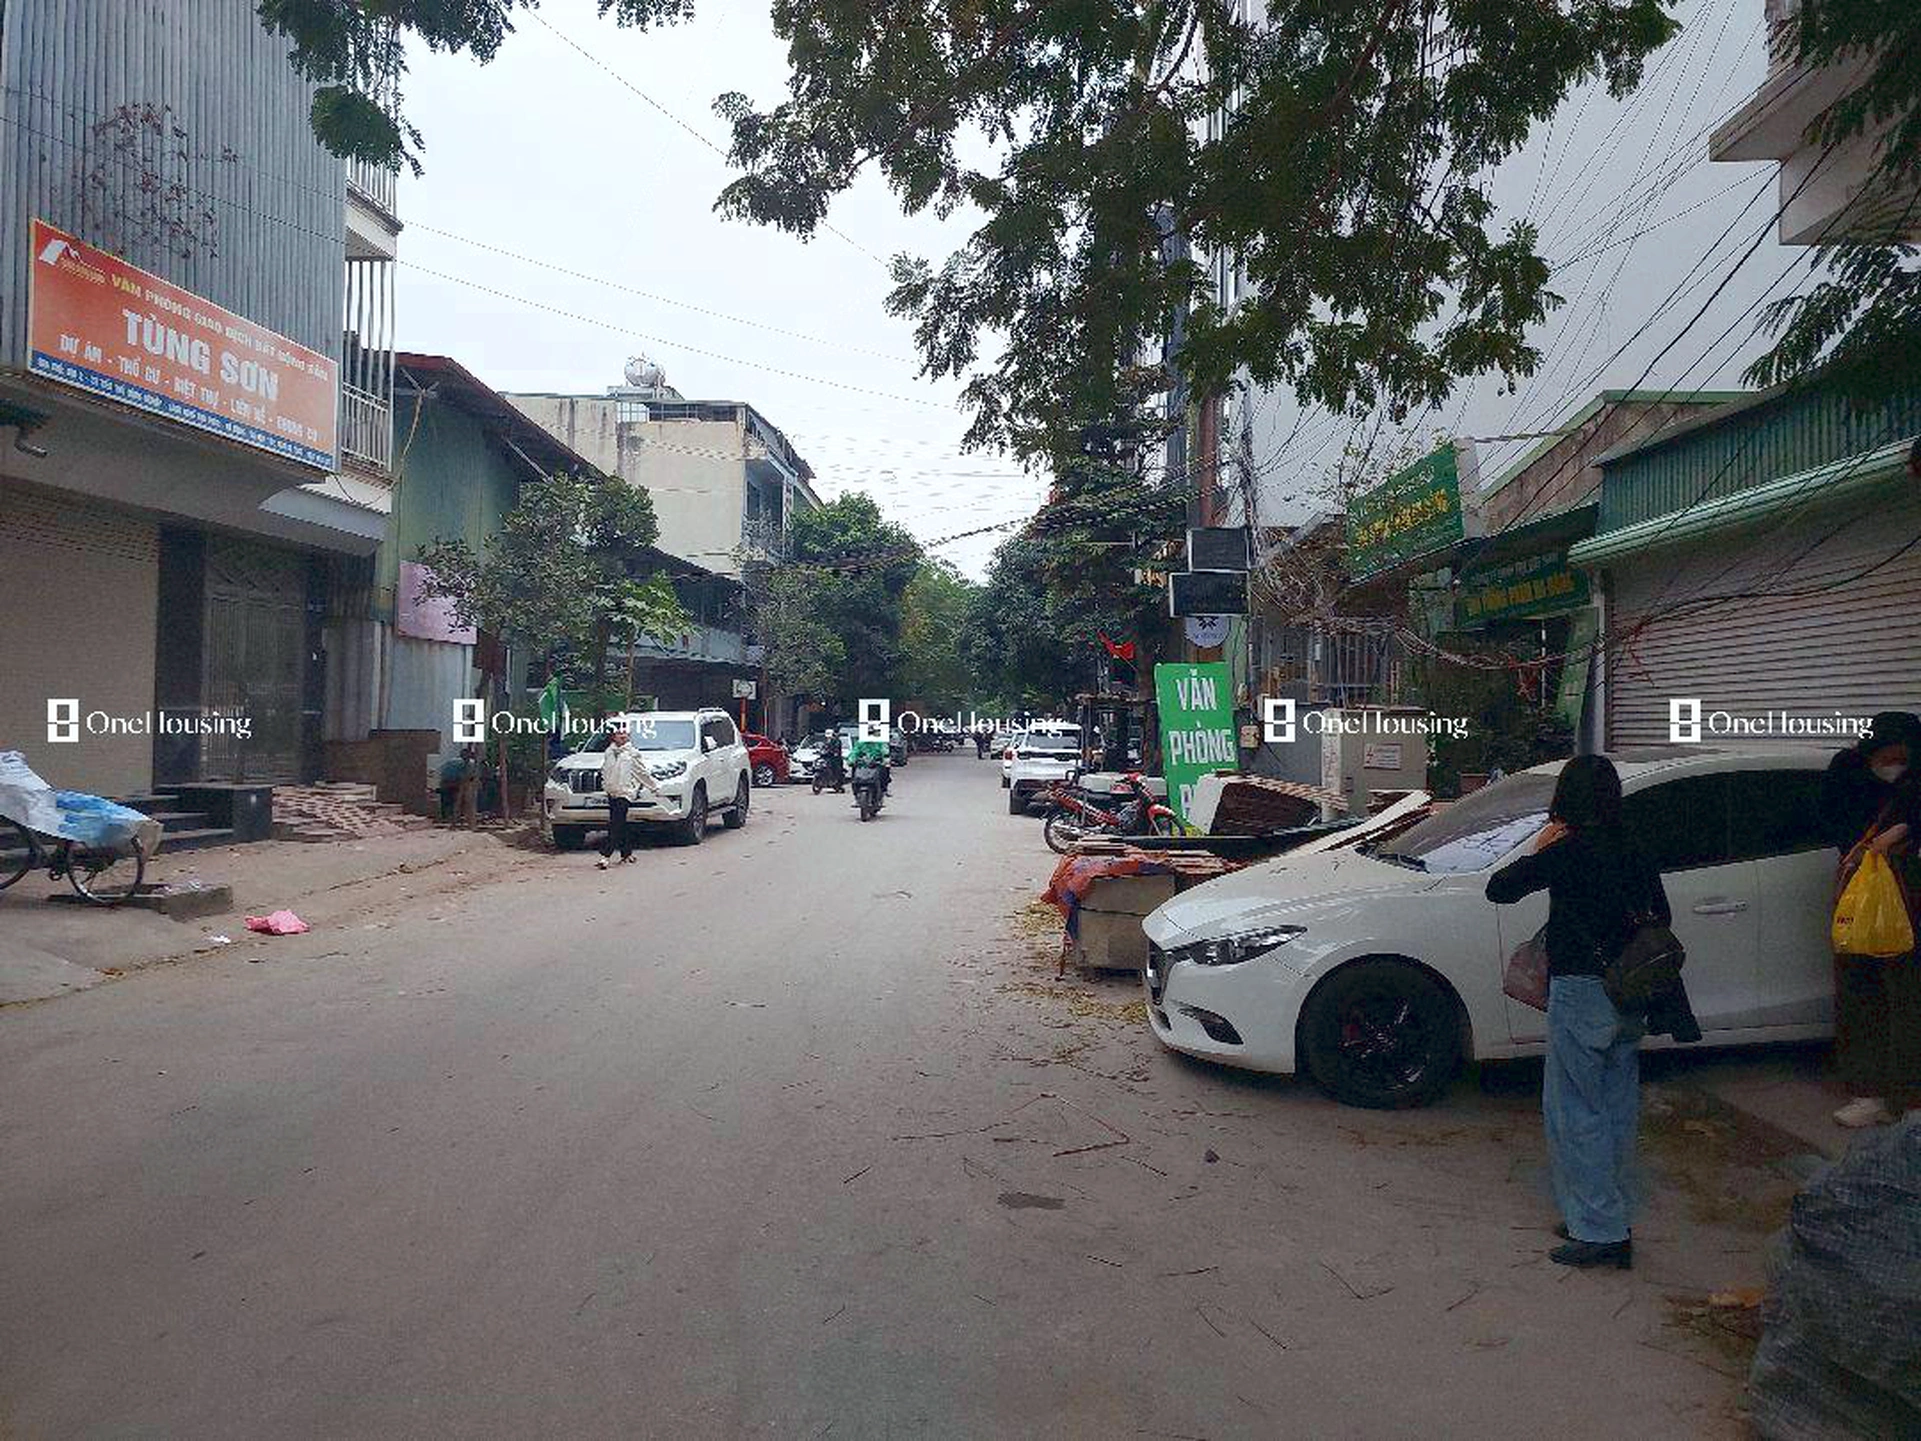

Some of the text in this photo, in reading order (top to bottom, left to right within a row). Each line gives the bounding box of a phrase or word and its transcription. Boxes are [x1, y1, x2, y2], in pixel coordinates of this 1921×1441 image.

[220, 350, 279, 401] SƠN
[1176, 668, 1217, 711] VĂN
[1168, 720, 1236, 766] PHÒNG
